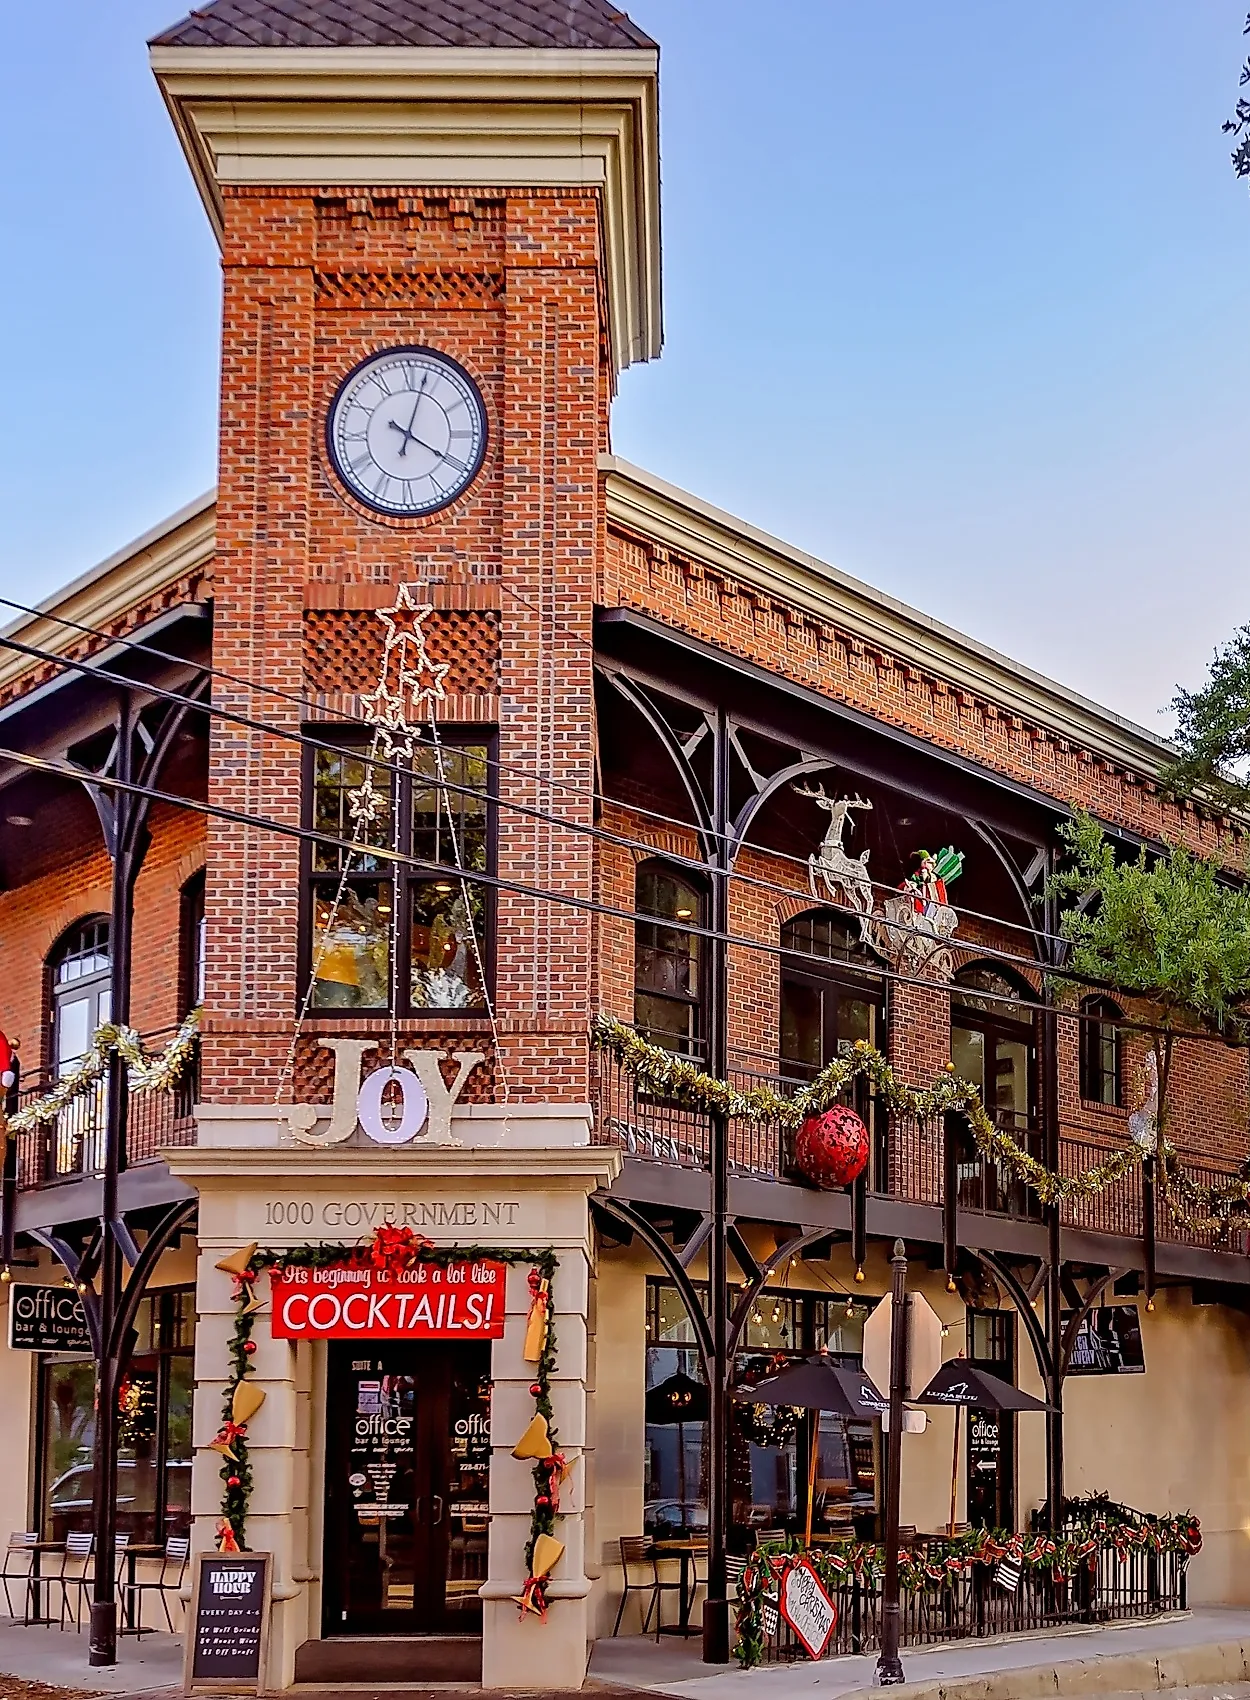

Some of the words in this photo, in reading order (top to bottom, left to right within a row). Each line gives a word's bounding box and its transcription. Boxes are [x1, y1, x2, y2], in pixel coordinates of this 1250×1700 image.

[287, 1038, 486, 1147] JOY
[264, 1201, 315, 1226] 1000
[322, 1201, 520, 1227] GOVERNMENT
[432, 1270, 442, 1283] a
[446, 1263, 466, 1283] lot
[471, 1263, 497, 1283] like
[16, 1289, 86, 1322] office
[282, 1293, 494, 1330] COCKTAILS!
[15, 1320, 34, 1331] bar
[39, 1323, 47, 1333] &
[52, 1324, 91, 1336] lounge
[352, 1360, 371, 1371] SUITE
[377, 1360, 383, 1370] A
[355, 1414, 411, 1435] office
[455, 1414, 491, 1435] offic
[972, 1421, 998, 1438] office
[382, 1437, 410, 1446] lounge
[210, 1572, 256, 1583] HAPPY
[213, 1582, 251, 1594] HOUR
